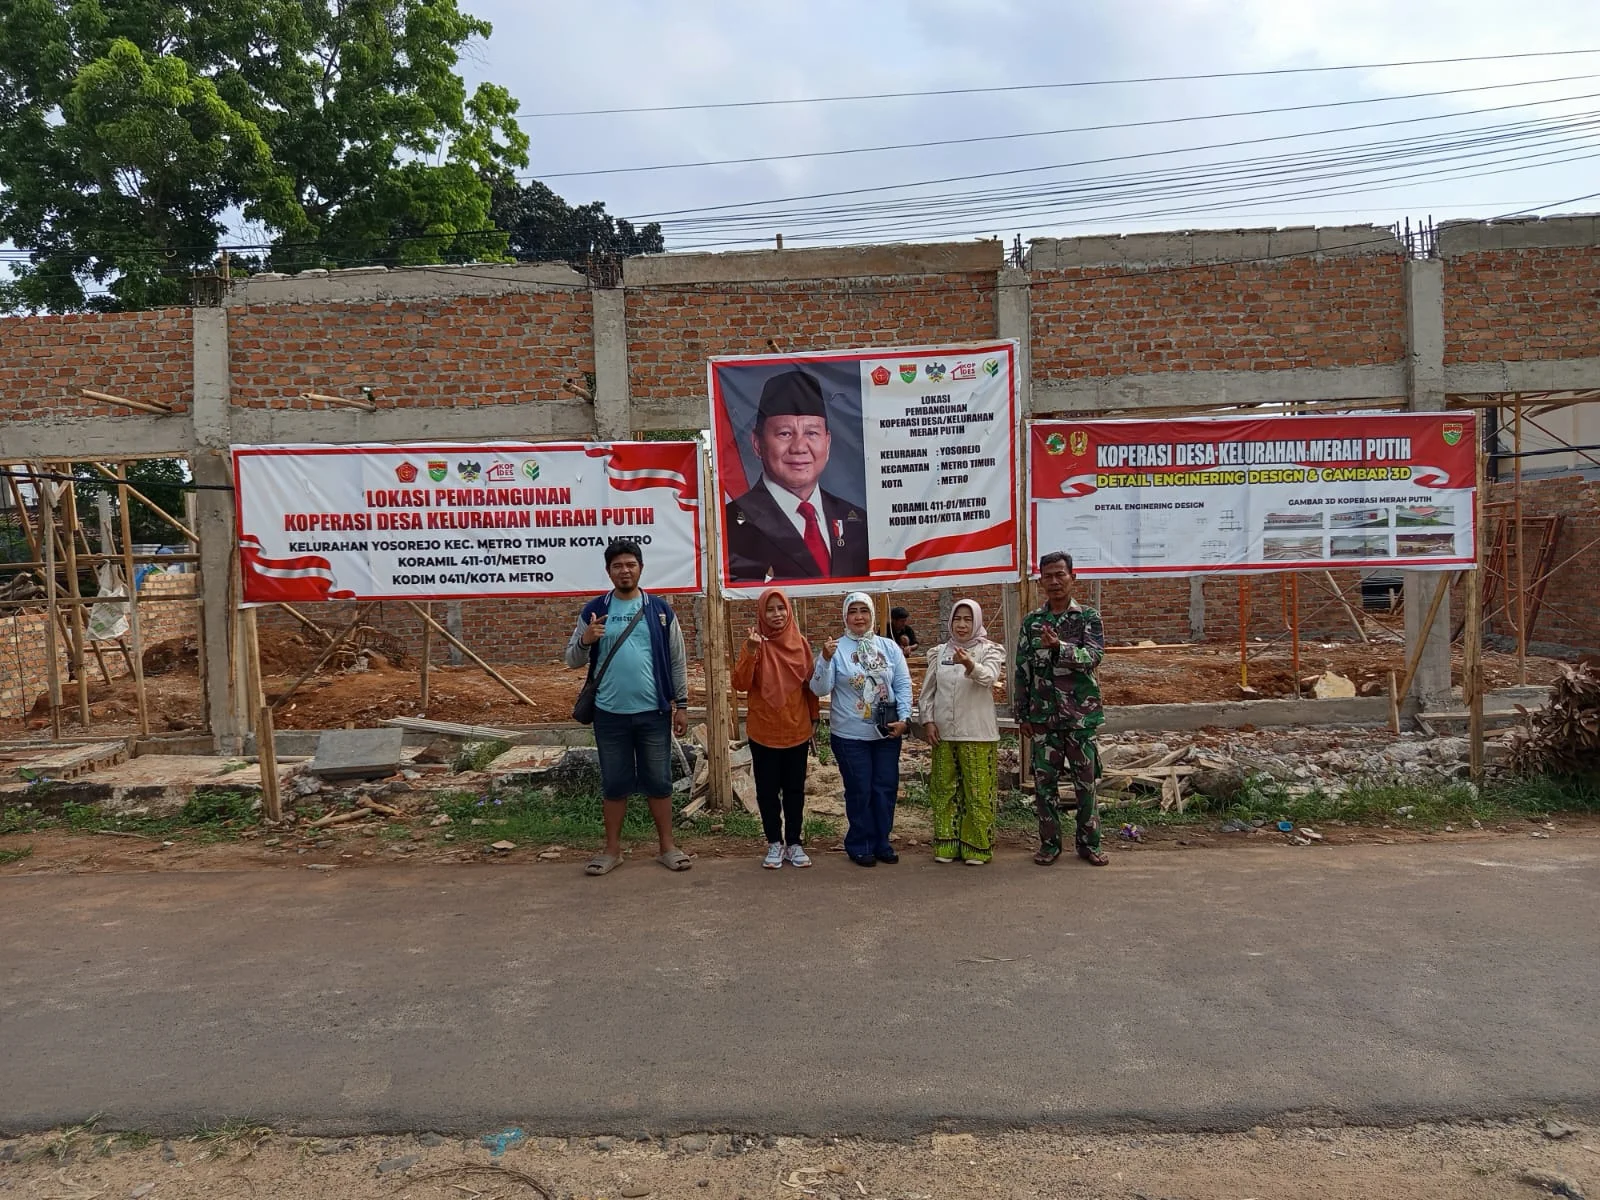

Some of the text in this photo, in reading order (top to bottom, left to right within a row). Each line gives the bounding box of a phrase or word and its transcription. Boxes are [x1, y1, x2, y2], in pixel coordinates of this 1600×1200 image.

[921, 394, 951, 405] LOKASI
[905, 403, 968, 416] PEMBANGUNAN
[880, 412, 994, 429] KOPERASI DESA/KELURAHAN
[909, 425, 965, 437] MERAH PUTIH
[880, 448, 928, 459] KELURAHAN
[1097, 437, 1411, 468] KOPERASI DESA KELURAHAN MERAH PUTIH
[881, 463, 930, 474] KECAMATAN
[970, 458, 996, 468] TIMUR
[881, 479, 903, 489] KOTA
[1096, 466, 1412, 488] DETAIL ENGINERING DESIGN & GAMBAR 3D
[367, 487, 571, 508] LOKASI PEMBANGUNAN
[892, 497, 987, 513] KORAMIL 411-01/METRO
[1288, 498, 1323, 506] GAMBAR
[1337, 497, 1378, 505] KOPERASI
[1379, 496, 1407, 504] MERAH
[1095, 501, 1205, 511] DETAIL ENGINERING DESIGN
[284, 507, 654, 532] KOPERASI DESA KELURAHAN MERAH PUTIH
[889, 509, 991, 526] KODIM 0411/KOTA METRO
[289, 541, 369, 552] KELURAHAN
[372, 539, 441, 551] YOSOREJO
[445, 539, 474, 550] KEC.
[478, 538, 522, 550] METRO
[526, 537, 566, 548] TIMUR
[570, 536, 604, 547] KOTA
[398, 553, 546, 567] KORAMIL 411-01/METRO
[392, 571, 554, 585] KODIM 0411/KOTA METRO
